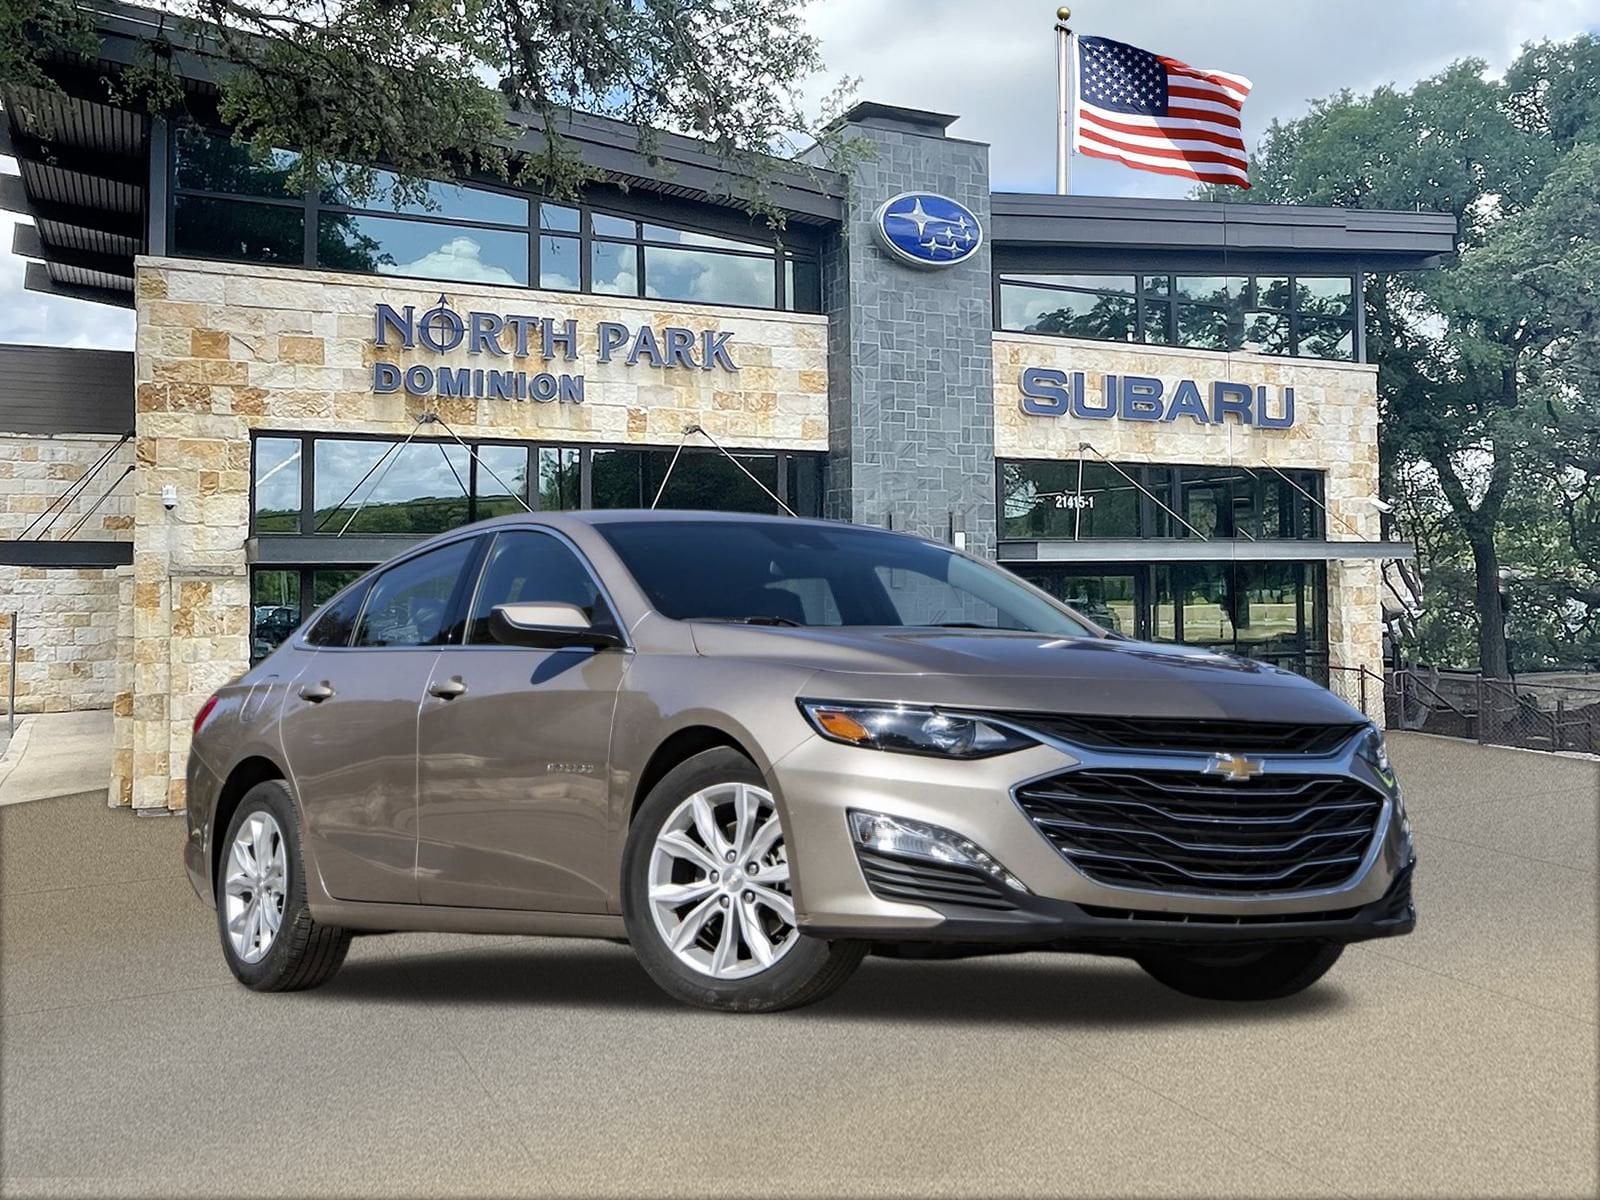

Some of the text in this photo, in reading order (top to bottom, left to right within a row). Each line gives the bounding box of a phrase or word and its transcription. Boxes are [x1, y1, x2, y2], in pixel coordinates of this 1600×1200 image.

[374, 295, 742, 372] NORTH PARK
[373, 362, 585, 403] DOMINION
[1019, 367, 1295, 429] SUBARU
